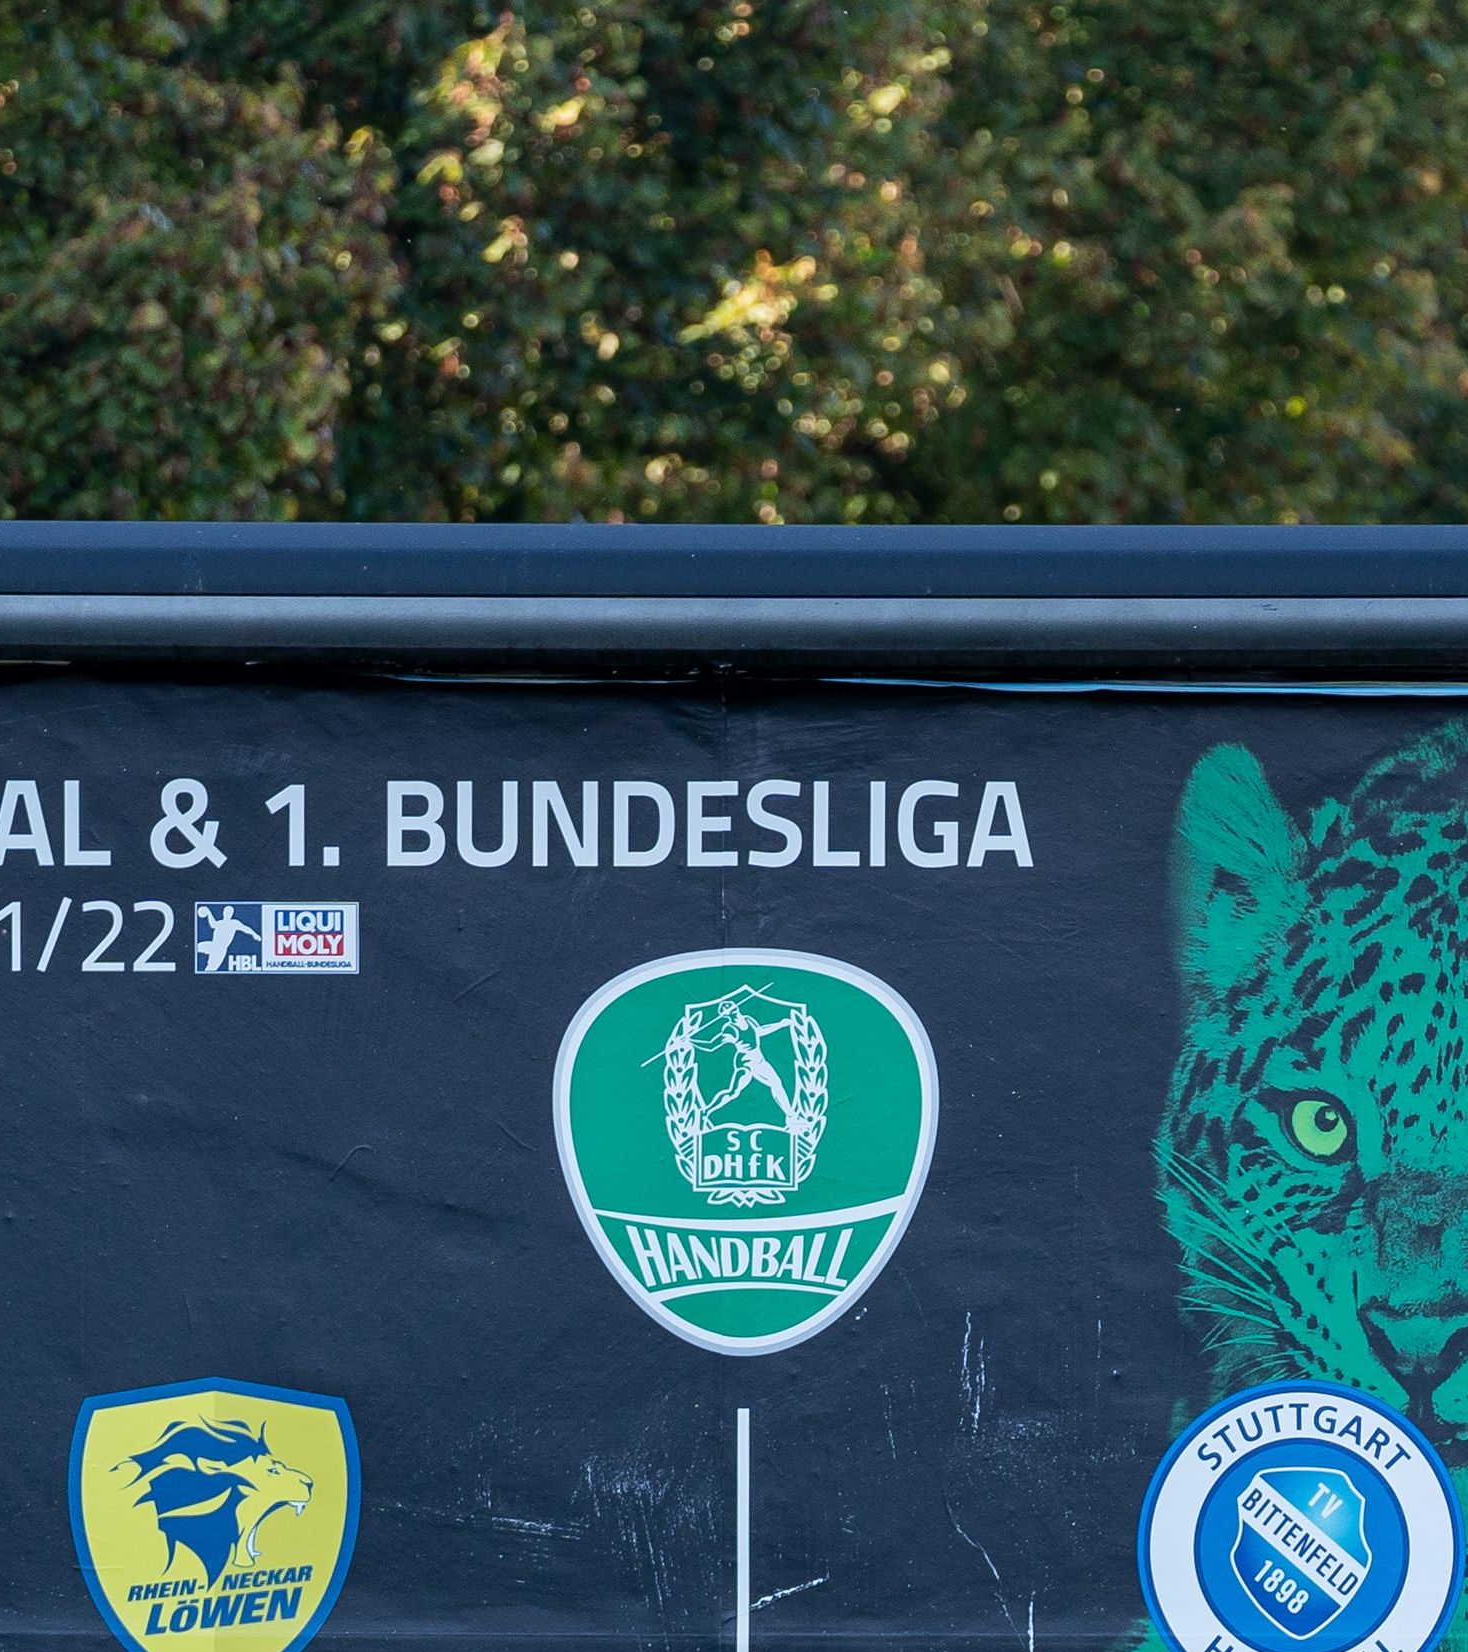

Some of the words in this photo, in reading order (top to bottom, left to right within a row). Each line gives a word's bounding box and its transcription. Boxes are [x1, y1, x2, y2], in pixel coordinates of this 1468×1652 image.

[150, 778, 227, 868] &
[265, 784, 340, 866] 1.
[387, 779, 1034, 868] BUNDESLIGA
[276, 911, 342, 933] LIQUI
[276, 934, 342, 955] MOLY
[228, 955, 262, 971] HBL
[704, 1153, 786, 1182] DHfK
[626, 1225, 854, 1288] HANDBALL
[1197, 1403, 1411, 1471] STUTTGART
[1308, 1482, 1344, 1519] TV
[1242, 1488, 1359, 1596] BITTENFELD
[145, 1586, 302, 1636] LÖWEN
[1254, 1560, 1310, 1614] 1898
